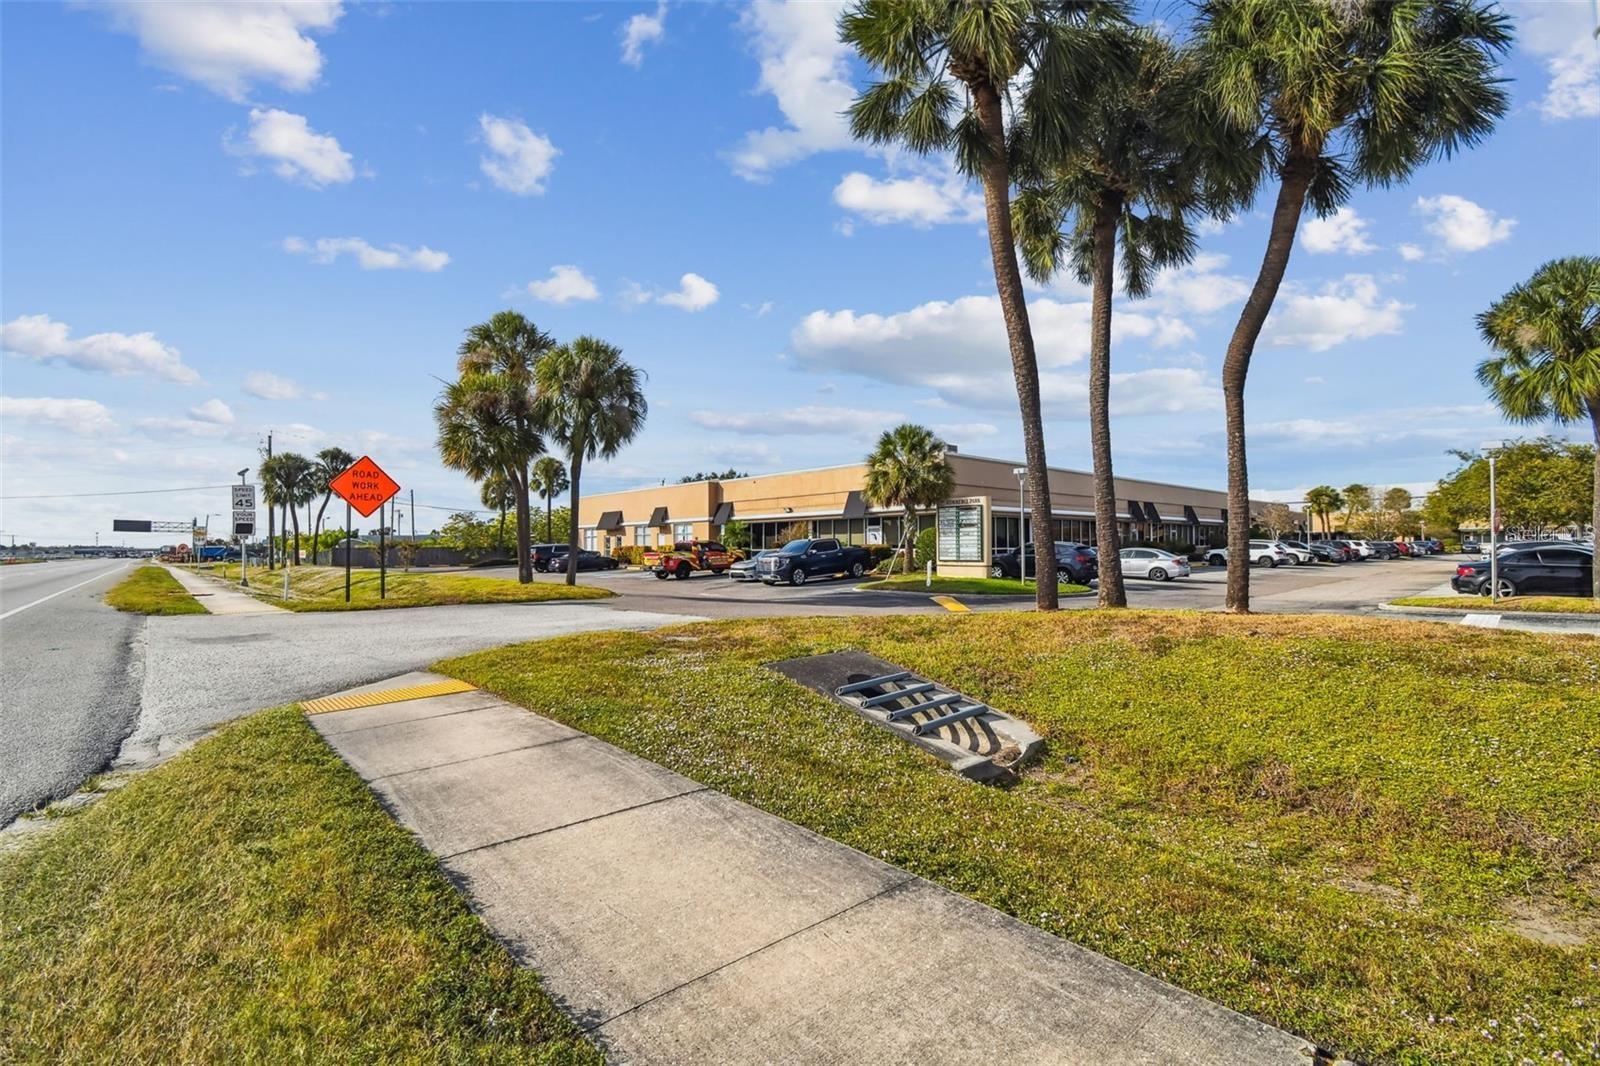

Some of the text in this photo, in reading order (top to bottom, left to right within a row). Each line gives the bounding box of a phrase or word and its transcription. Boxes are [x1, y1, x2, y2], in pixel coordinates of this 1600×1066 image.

[352, 470, 379, 479] ROAD
[352, 481, 379, 490] WORK
[350, 493, 383, 501] AHEAD
[235, 499, 253, 508] 45
